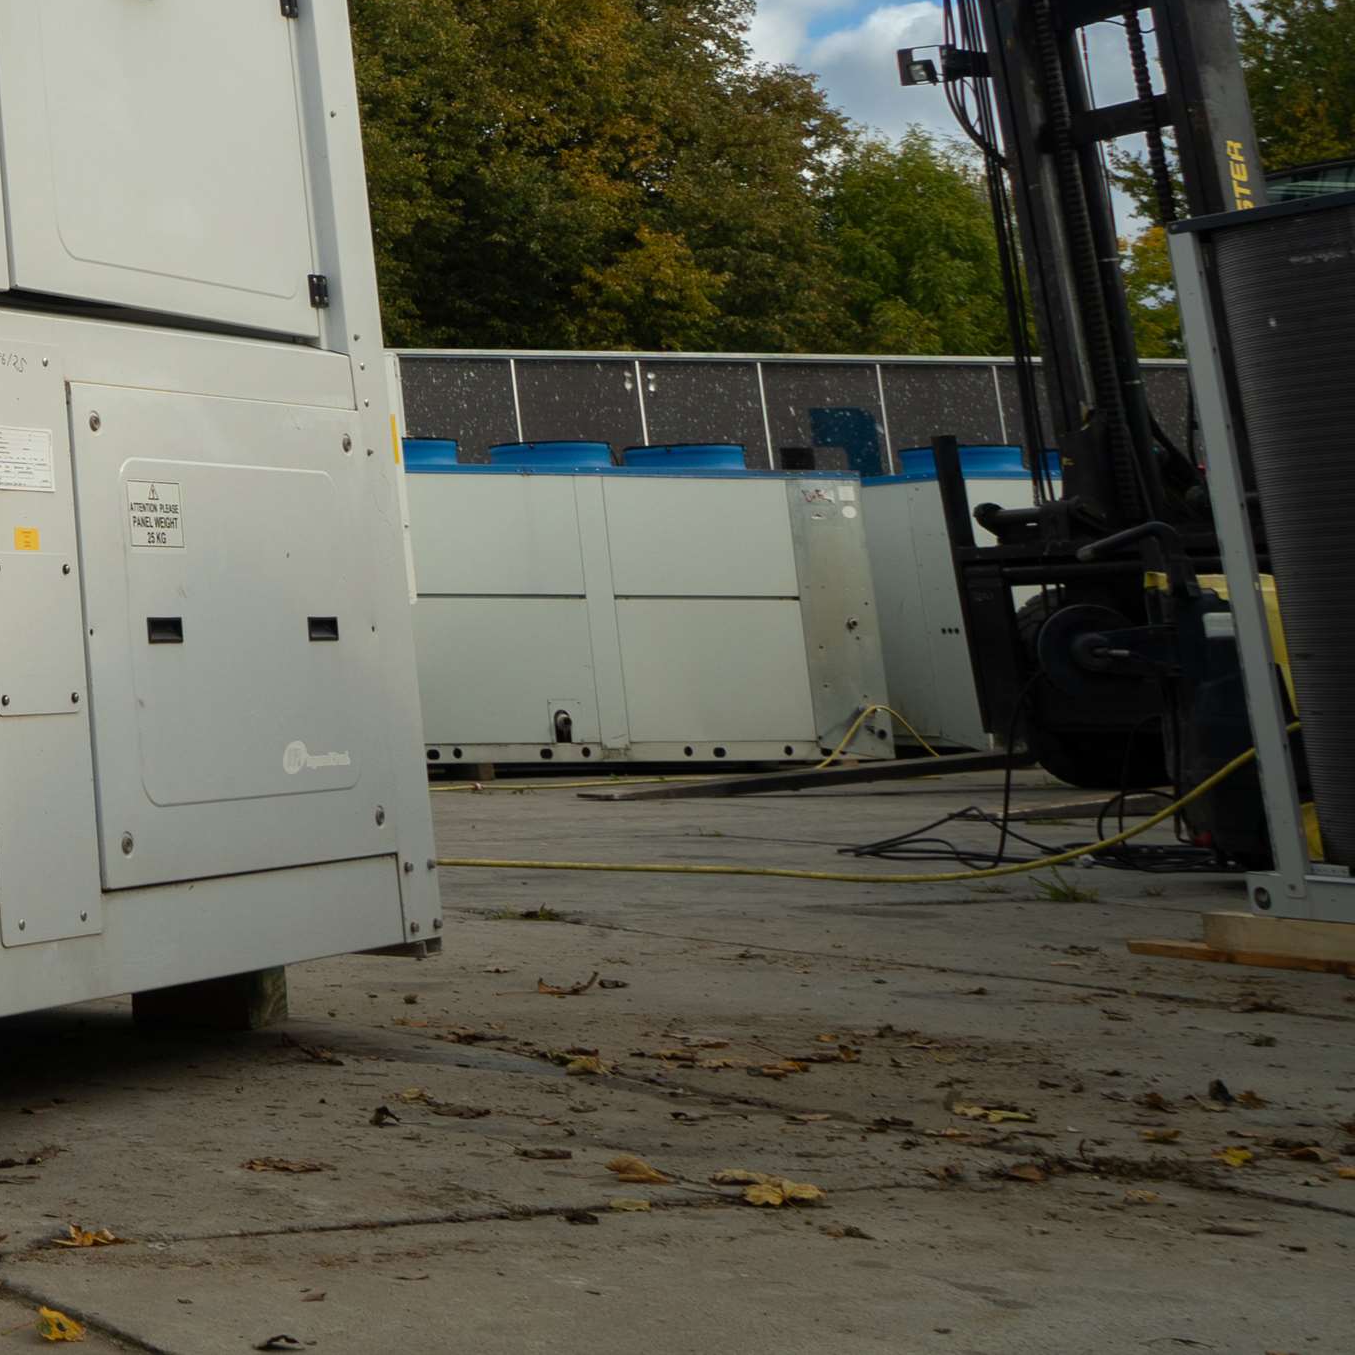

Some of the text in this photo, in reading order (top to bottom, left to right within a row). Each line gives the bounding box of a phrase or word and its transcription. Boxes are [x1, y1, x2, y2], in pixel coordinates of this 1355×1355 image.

[130, 501, 179, 514] ATTENTION PLEASE
[132, 515, 178, 529] PANEL WEIGHT
[156, 531, 167, 544] KG
